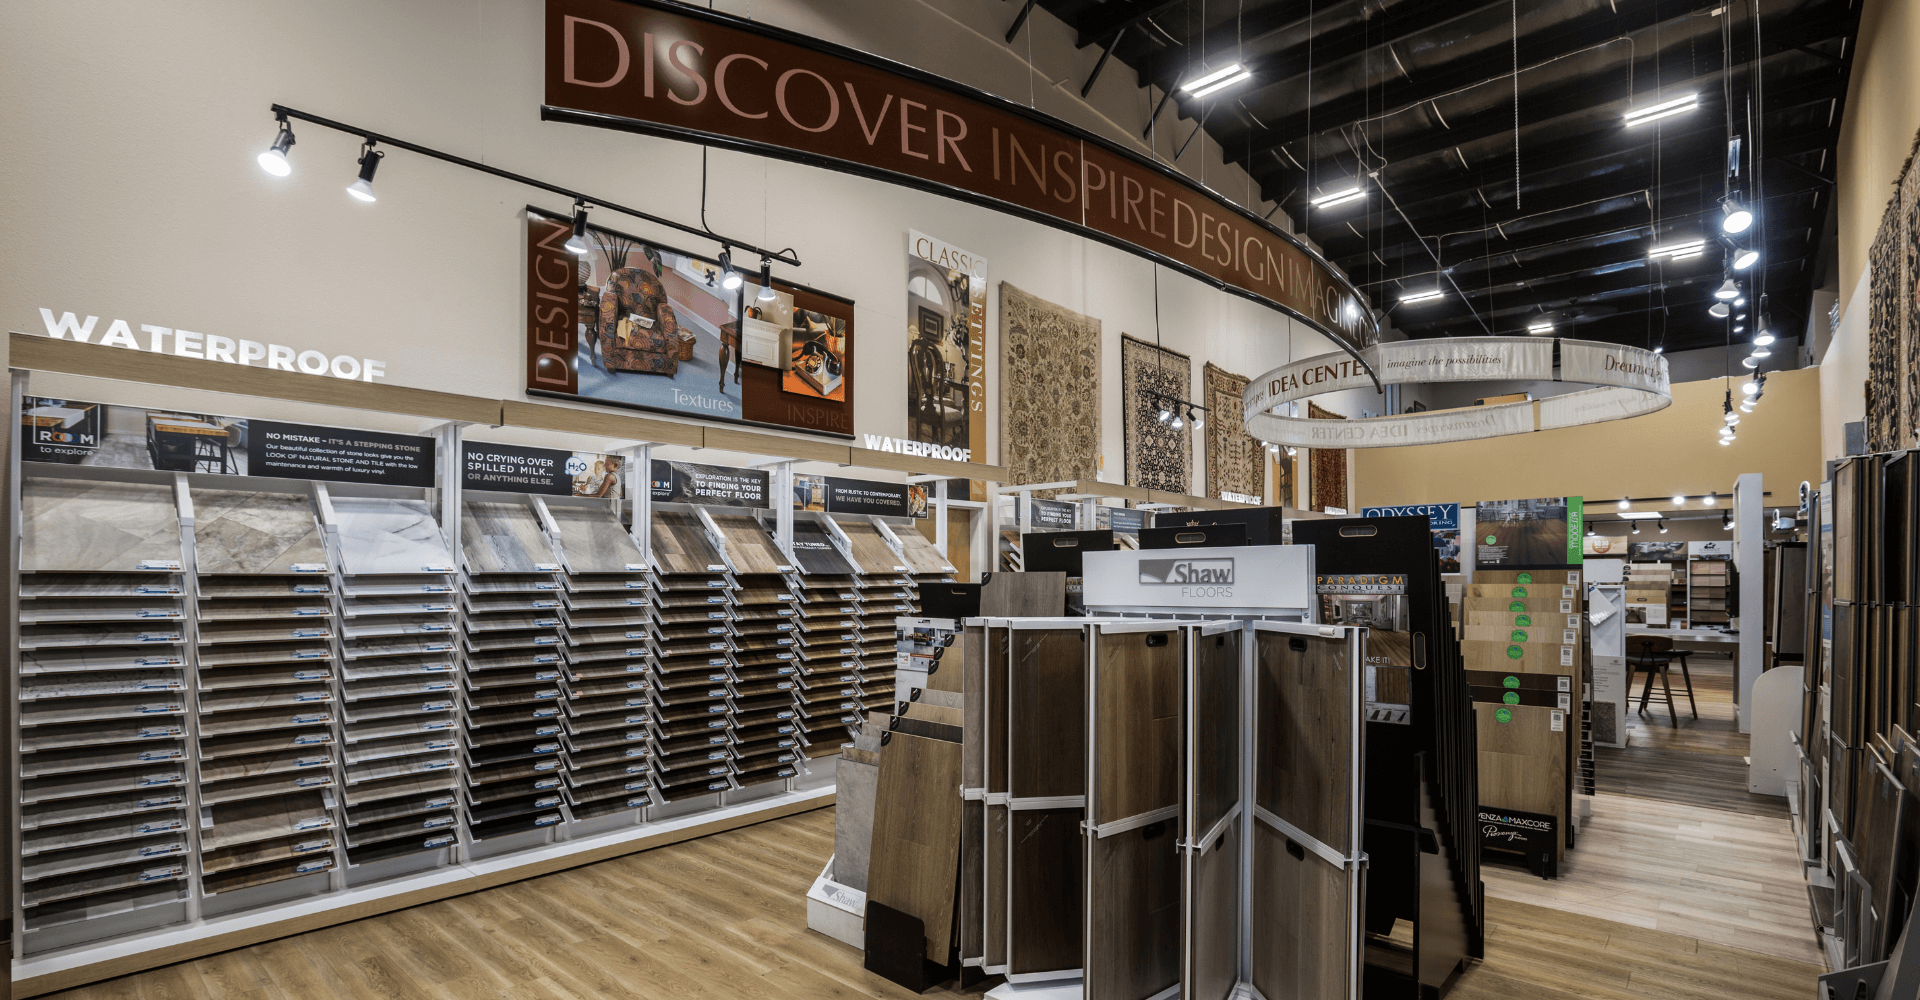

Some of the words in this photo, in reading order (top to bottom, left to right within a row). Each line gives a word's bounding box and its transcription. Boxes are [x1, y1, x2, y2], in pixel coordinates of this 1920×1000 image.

[563, 15, 973, 173] DISCOVER
[992, 127, 1166, 239] INSPIRE
[1173, 198, 1285, 292] DESIGN
[916, 237, 985, 281] CLASSIC
[535, 219, 570, 387] DESIGN
[38, 307, 386, 383] WATERPROOF
[970, 286, 983, 412] SETTINGS
[1387, 357, 1426, 369] imagine
[1428, 356, 1443, 366] the
[1445, 354, 1502, 367] possibilities
[1268, 373, 1299, 397] IDEA
[1302, 359, 1369, 386] CENTE
[671, 388, 734, 412] Textures
[787, 404, 848, 430] INSPIRE
[266, 432, 281, 440] NO
[282, 434, 321, 444] MISTAKE
[328, 438, 344, 446] IT'S
[353, 441, 393, 450] STEPPING
[394, 444, 421, 453] STONE
[280, 444, 307, 452] beautiful
[308, 447, 337, 455] collection
[863, 433, 971, 462] WATERPROOF
[299, 454, 331, 463] NATURAL
[332, 457, 354, 465] STONE
[467, 452, 484, 461] NO
[486, 453, 525, 465] CRYING
[527, 457, 554, 467] OVER
[266, 461, 306, 469] maintenance
[352, 466, 370, 474] luxury
[467, 462, 515, 473] SPILLED
[483, 474, 528, 484] ANYTHING
[695, 473, 731, 482] EXPLORATION
[708, 481, 739, 490] FINDING
[741, 484, 761, 492] YOUR
[695, 489, 732, 498] PERFECT
[735, 491, 761, 500] FLOOR
[1174, 562, 1231, 584] Shaw
[1317, 576, 1404, 585] PARADIGM
[1181, 586, 1233, 598] FLOORS
[1366, 656, 1380, 664] AKE
[1508, 816, 1551, 829] MAXCORE
[833, 891, 860, 908] Shaw
